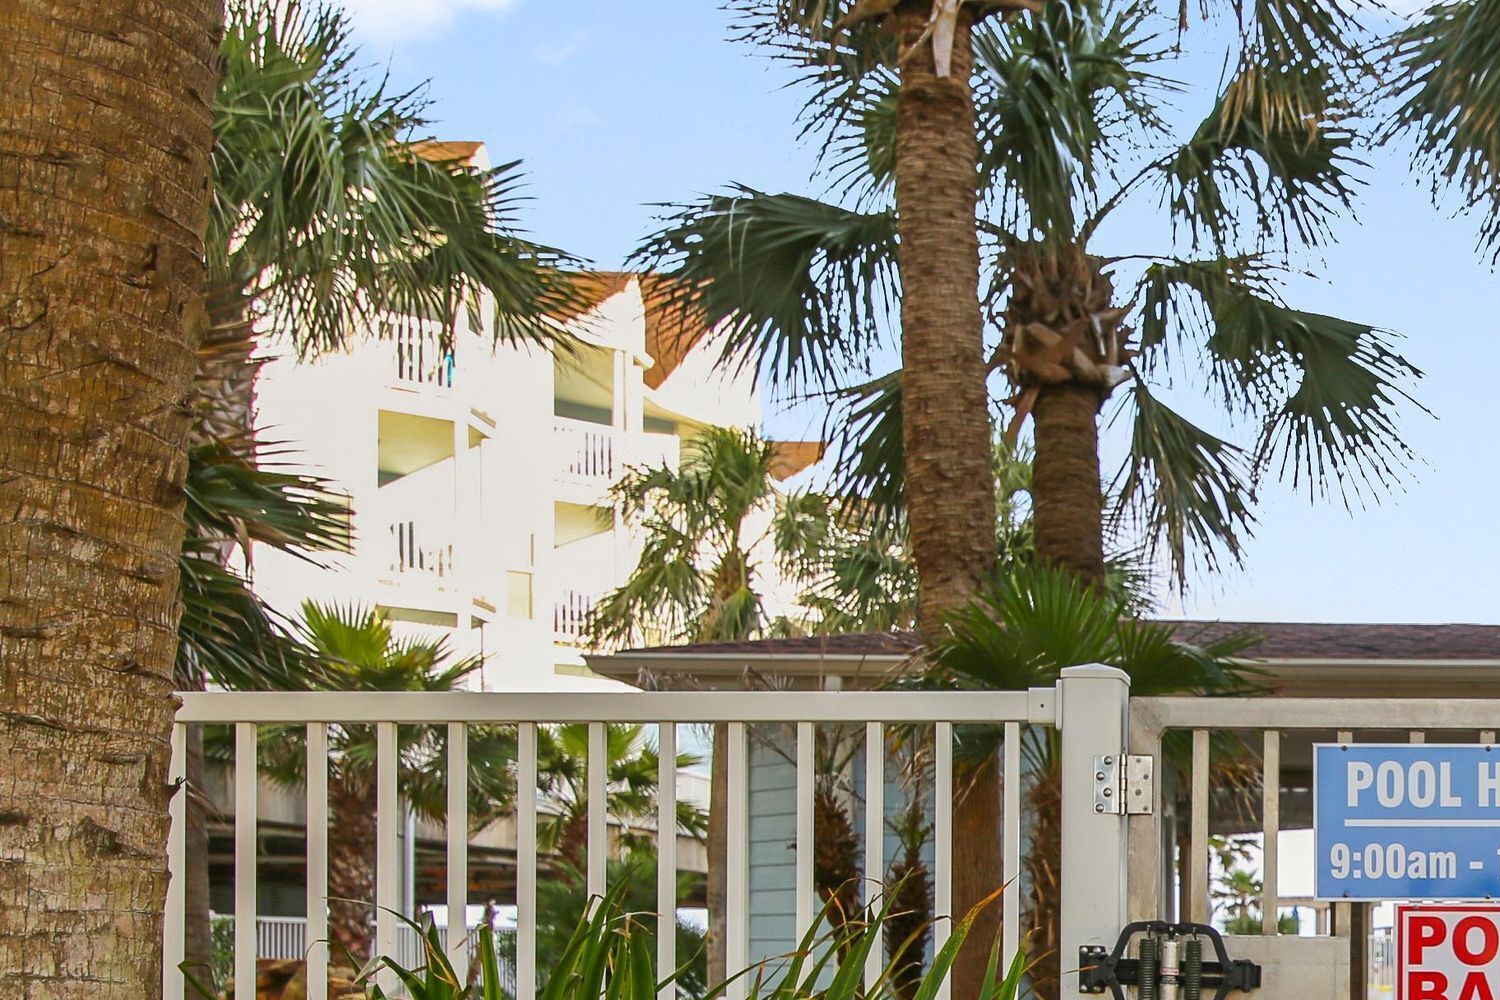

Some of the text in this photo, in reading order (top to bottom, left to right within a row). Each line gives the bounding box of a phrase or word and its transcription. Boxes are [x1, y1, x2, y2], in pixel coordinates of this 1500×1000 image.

[1348, 759, 1462, 808] POOL
[1330, 843, 1457, 880] 9:00am
[1469, 860, 1484, 870] -
